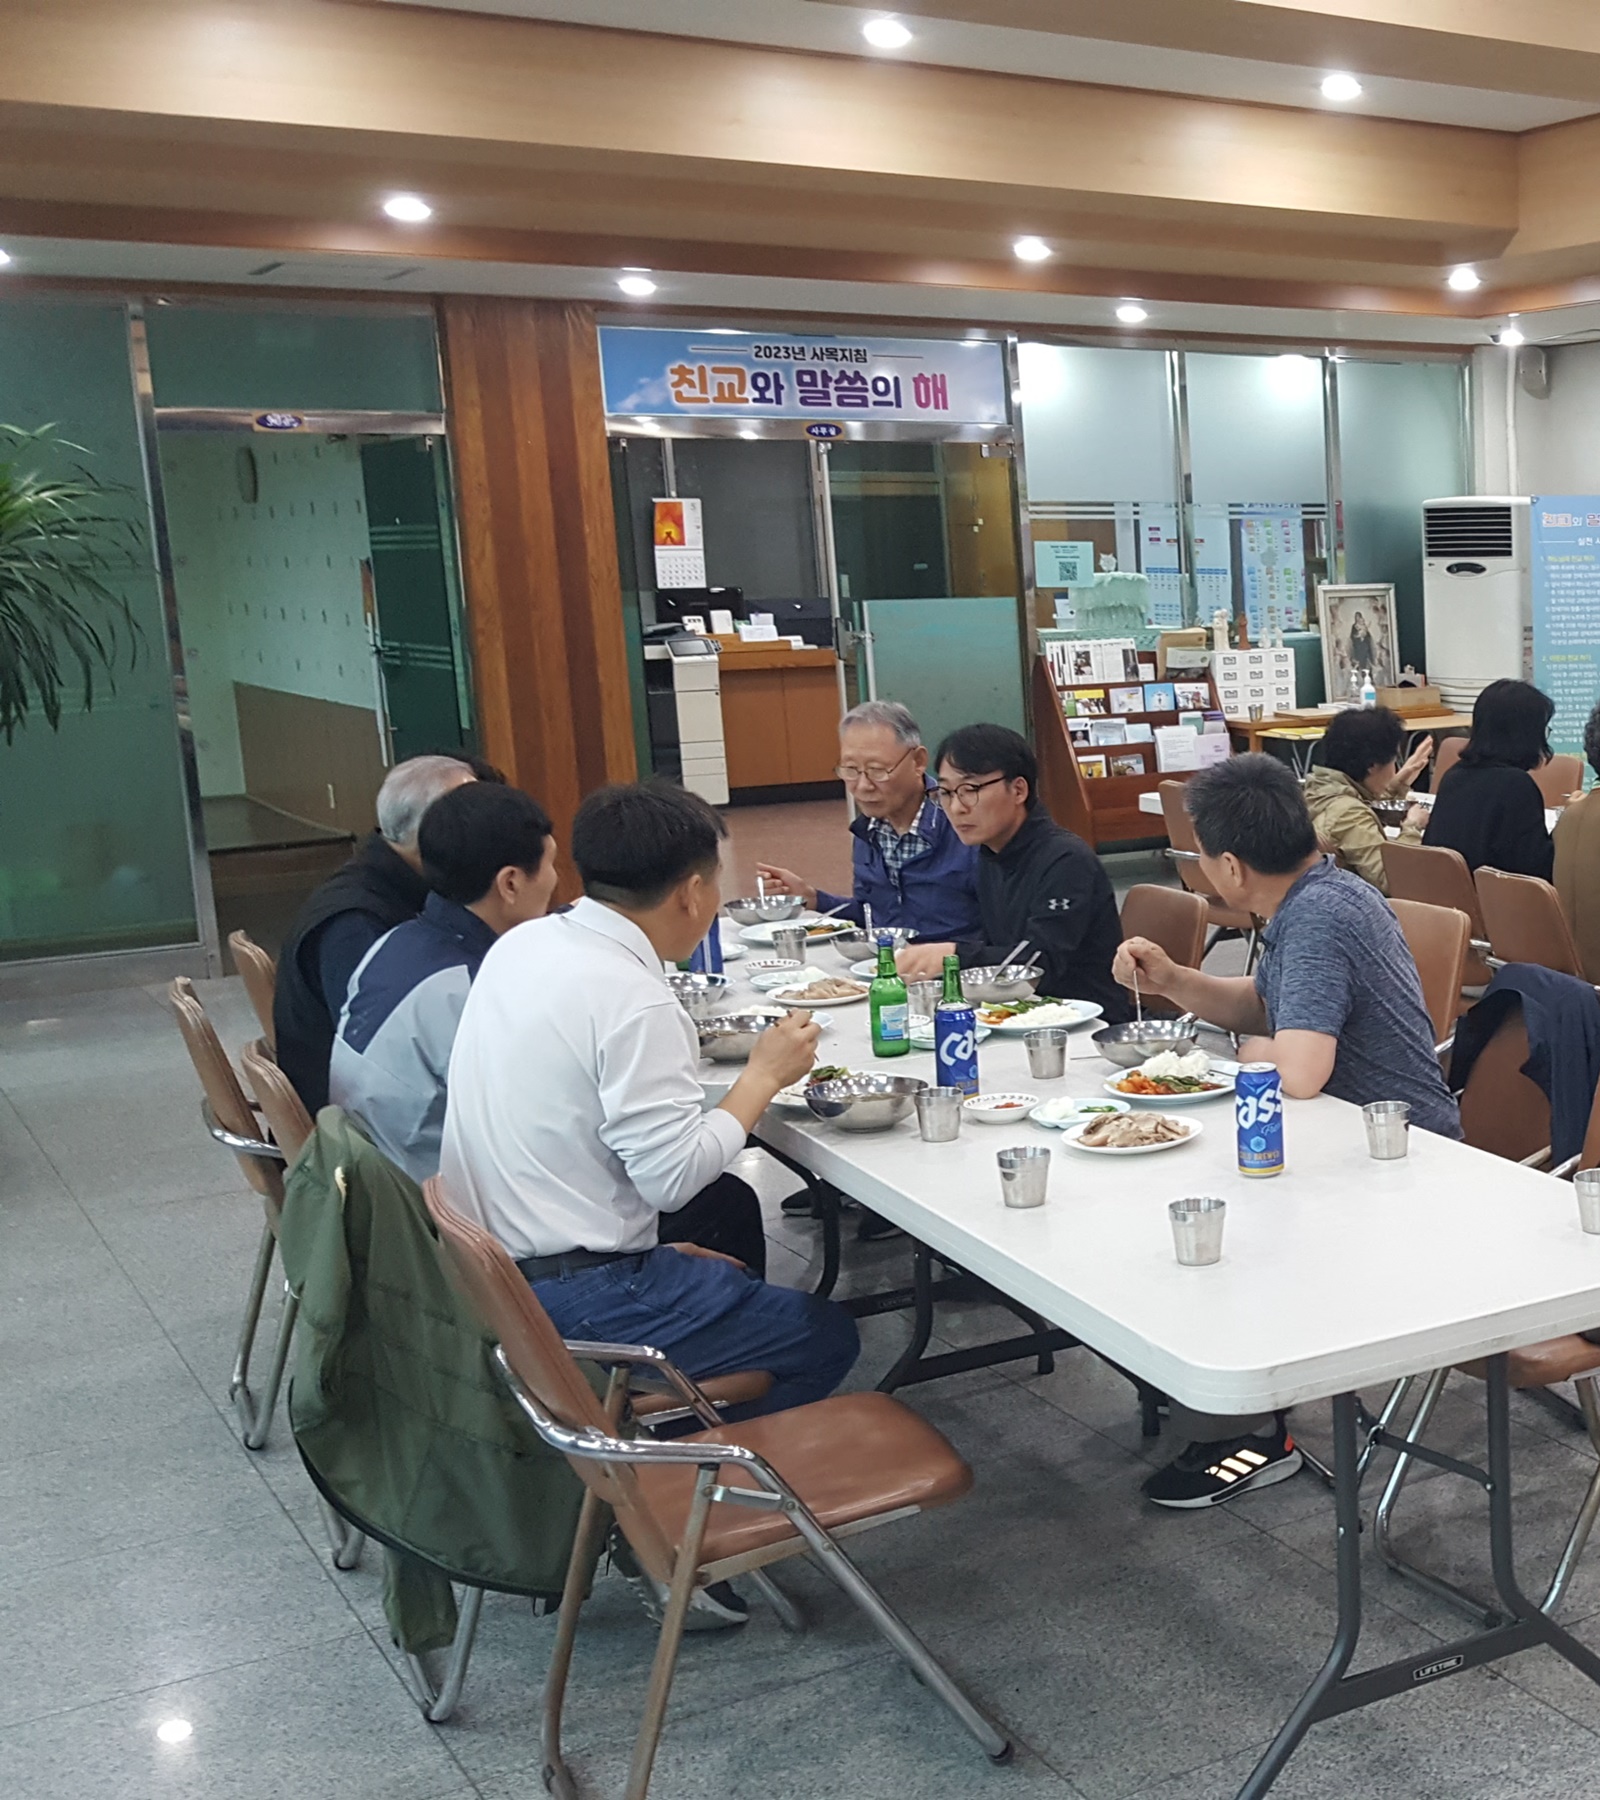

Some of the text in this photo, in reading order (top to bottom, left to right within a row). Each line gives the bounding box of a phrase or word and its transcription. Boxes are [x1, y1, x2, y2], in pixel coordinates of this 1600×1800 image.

[753, 345, 868, 363] 2023년 사목지침
[669, 364, 949, 410] 친교와 말씀의 해
[810, 426, 836, 436] 사무실
